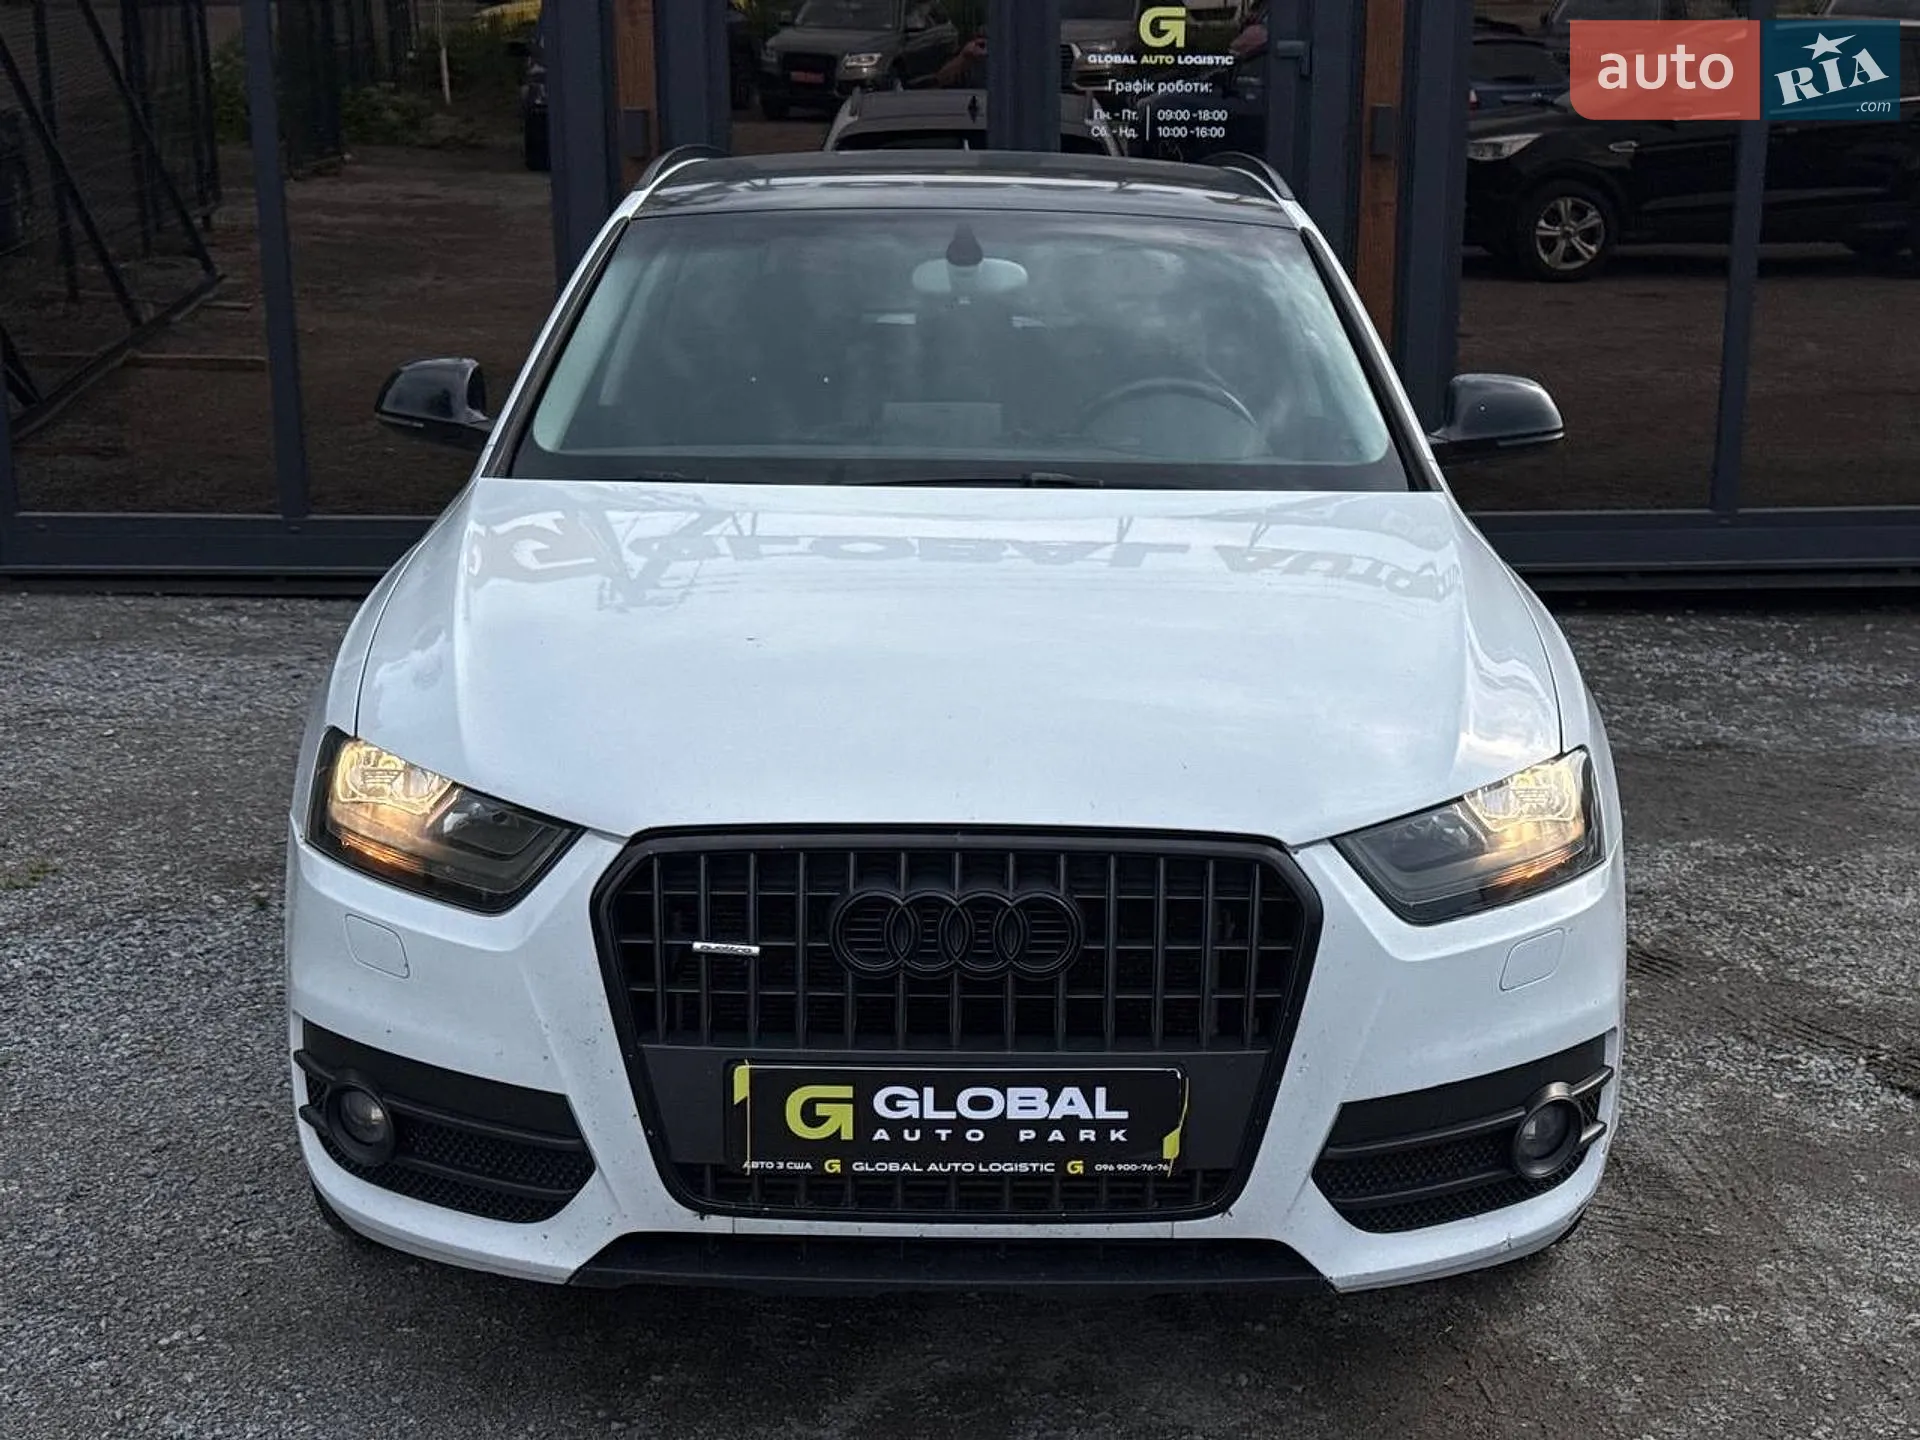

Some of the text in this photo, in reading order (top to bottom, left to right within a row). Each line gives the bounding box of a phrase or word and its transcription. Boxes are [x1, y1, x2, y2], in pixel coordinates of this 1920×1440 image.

[1087, 54, 1234, 66] GLOBAL AUTO LOGISTIC
[1108, 79, 1213, 94] Графік роботи:
[872, 1086, 1128, 1120] GLOBAL
[872, 1129, 1128, 1142] AUTO PARK
[786, 1162, 813, 1170] США
[852, 1162, 1055, 1173] GLOBAL AUTO LOGISTIC
